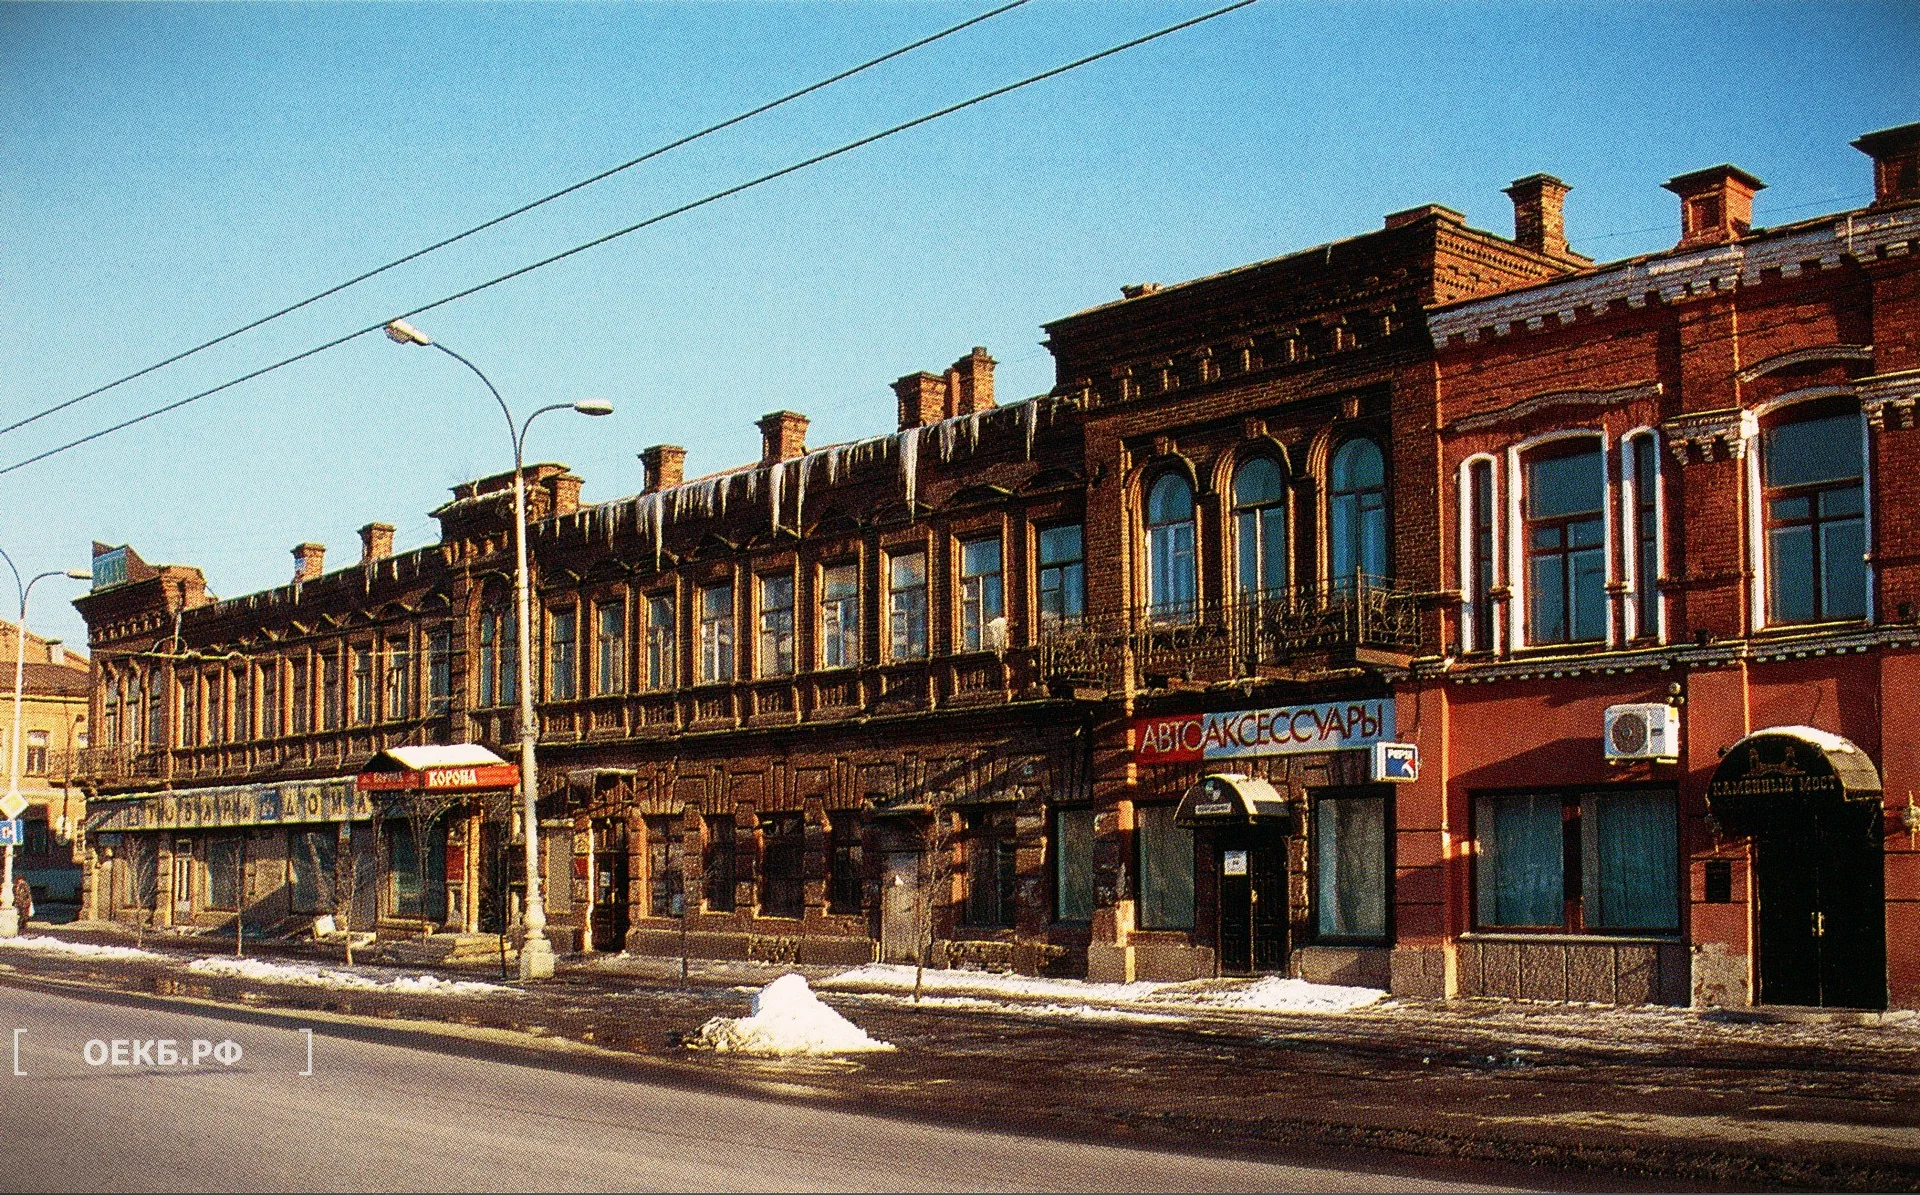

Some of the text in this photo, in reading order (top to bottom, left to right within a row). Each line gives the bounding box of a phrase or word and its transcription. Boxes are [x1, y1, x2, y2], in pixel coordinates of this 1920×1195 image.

[1140, 703, 1383, 754] АВТОАКСЕССУАРЫ
[429, 769, 478, 786] КОРОНА
[1799, 774, 1836, 792] МОСТ
